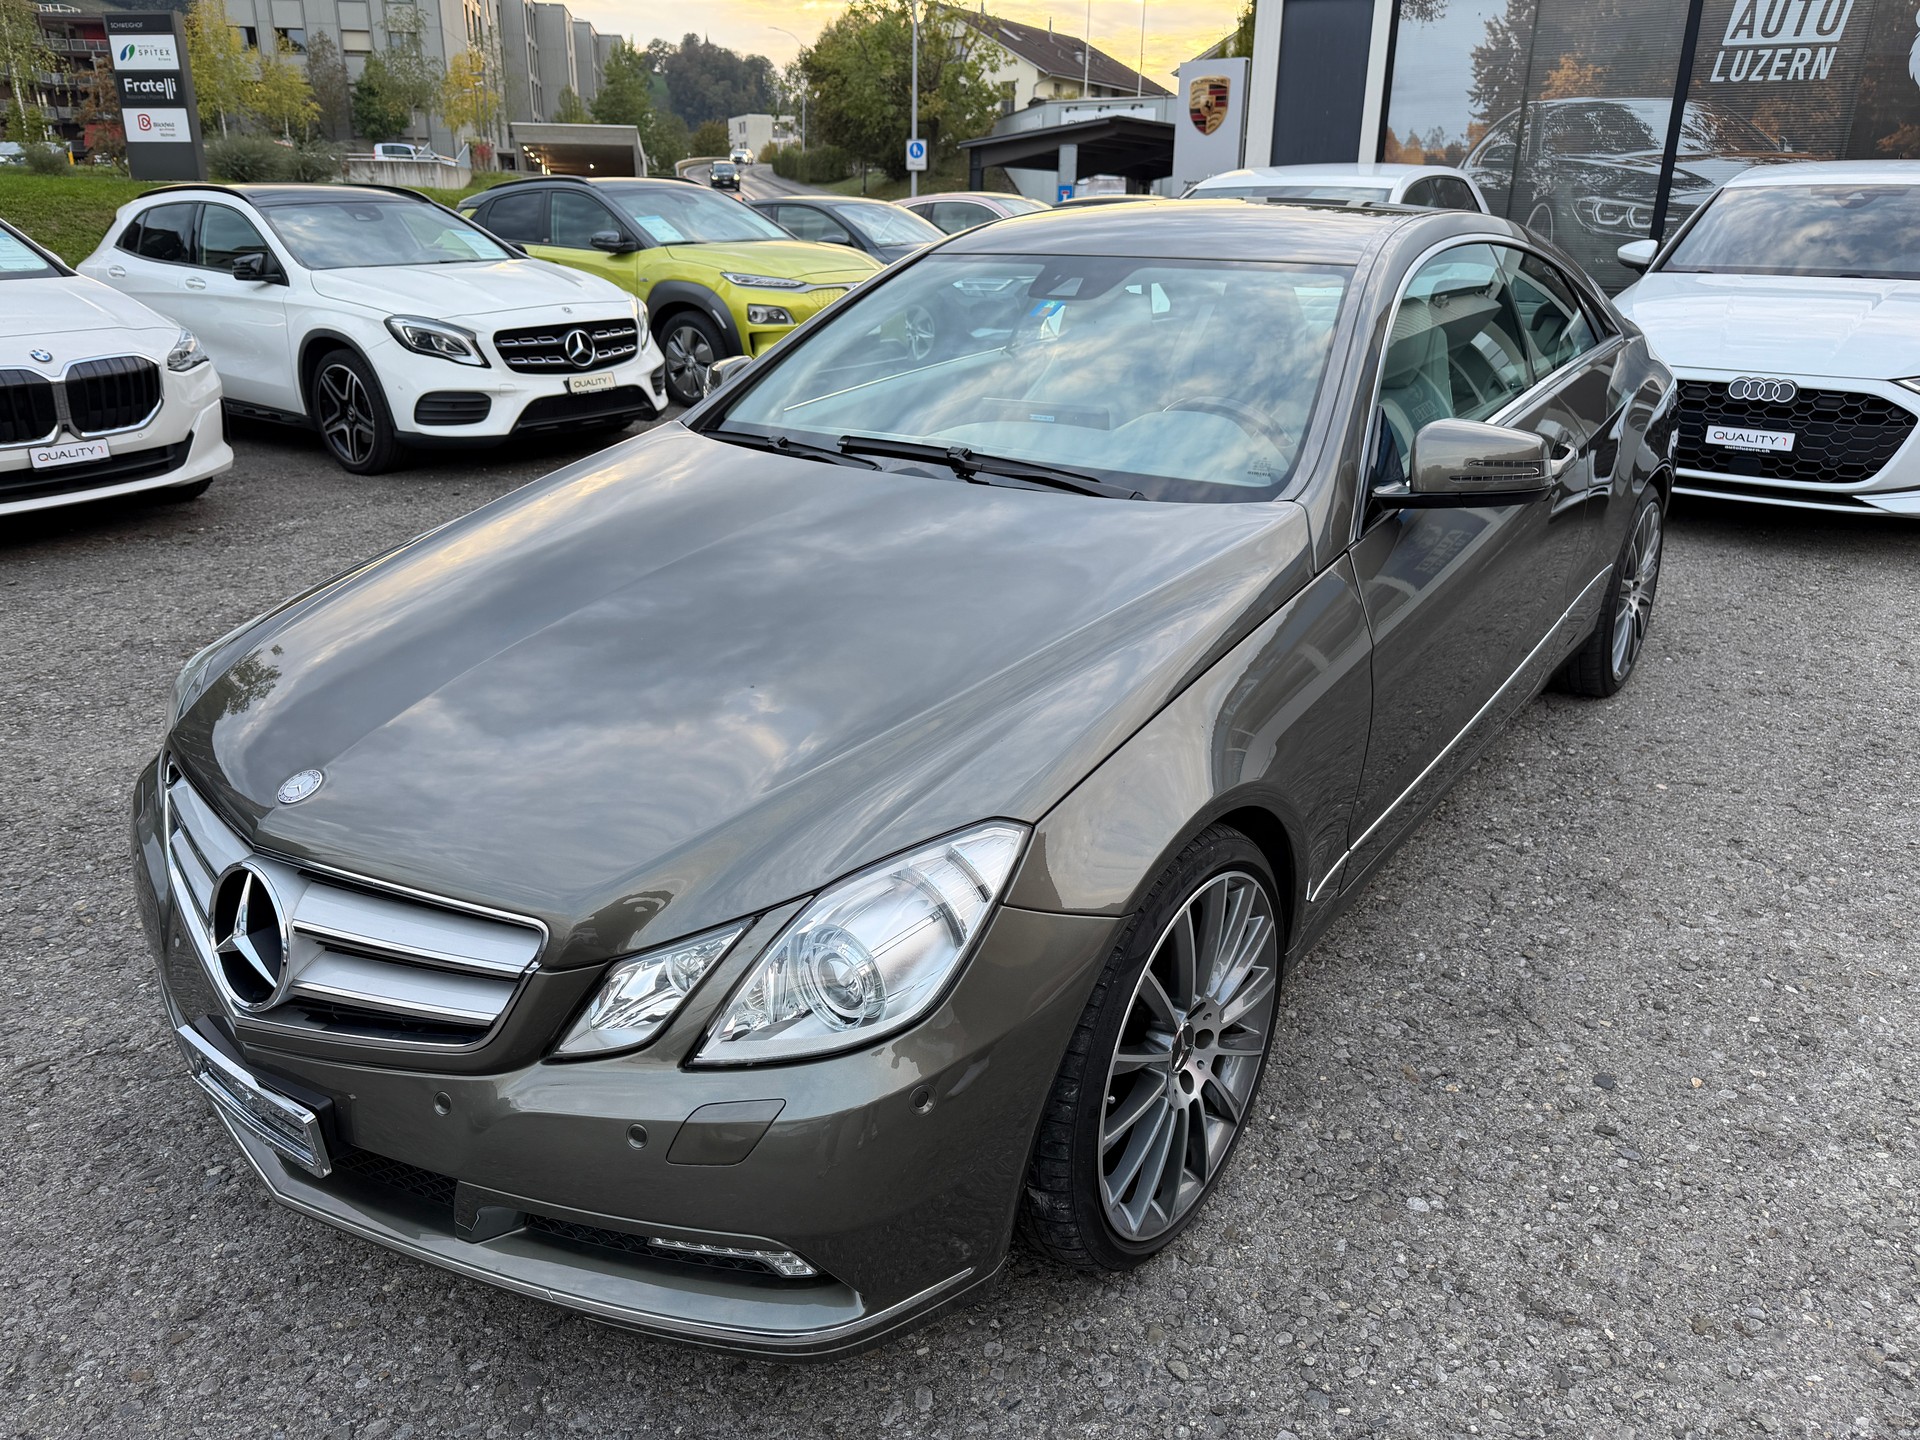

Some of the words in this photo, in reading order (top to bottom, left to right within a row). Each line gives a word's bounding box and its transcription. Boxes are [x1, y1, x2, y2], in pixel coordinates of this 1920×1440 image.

[110, 21, 143, 29] SCHWEIGHOF
[1728, 0, 1844, 39] AUTO
[1709, 46, 1838, 82] LUZERN
[123, 77, 177, 100] Fratelli
[573, 377, 607, 388] QUALITY
[1713, 430, 1779, 445] QUALITY
[1782, 437, 1787, 446] 1
[37, 446, 96, 462] QUALITY
[97, 445, 104, 454] 1
[1724, 444, 1771, 454] autoluzern.ch
